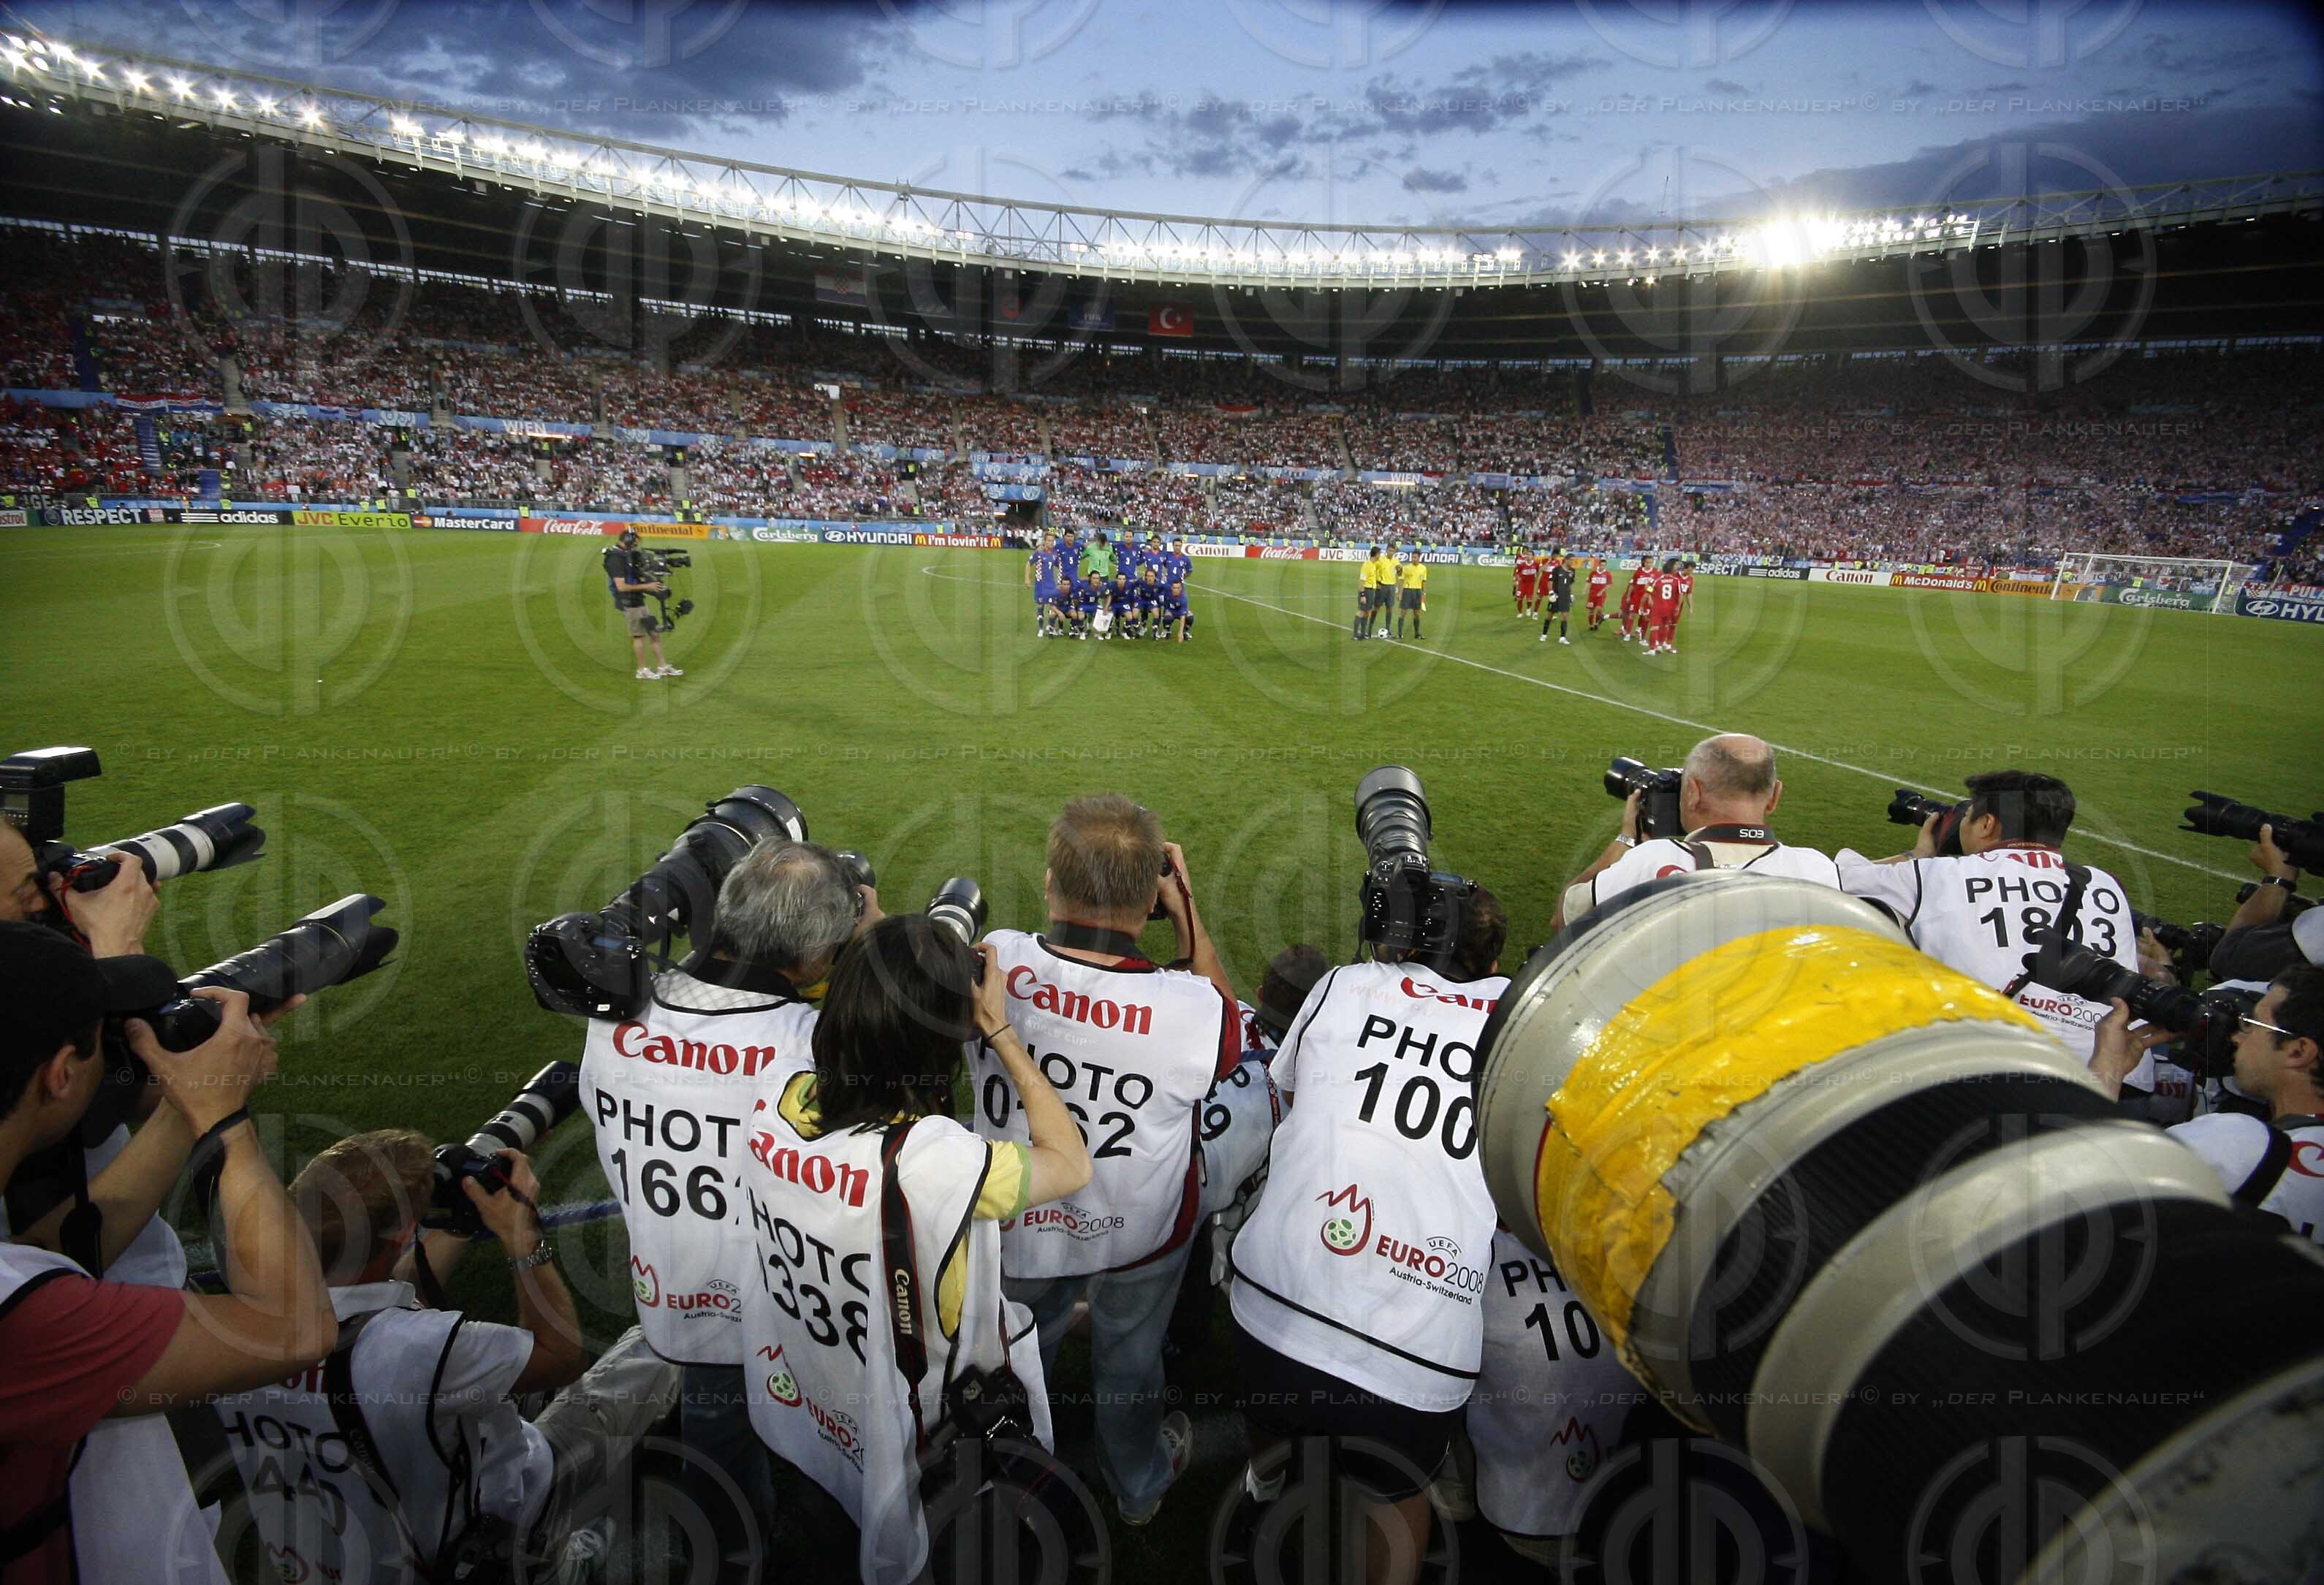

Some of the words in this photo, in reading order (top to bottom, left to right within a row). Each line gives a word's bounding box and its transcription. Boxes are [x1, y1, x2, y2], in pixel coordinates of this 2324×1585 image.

[501, 419, 547, 434] WIEN
[1391, 472, 1420, 483] WIEN
[61, 509, 141, 525] RESPECT
[221, 511, 278, 524] adidas
[297, 512, 334, 525] JVC
[338, 513, 409, 528] Everio
[434, 517, 514, 531] MasterCard
[752, 526, 819, 543] Carlsberg
[846, 531, 912, 544] HYUNDAI
[928, 534, 945, 546] i'm
[1184, 544, 1229, 556] Canon
[1321, 550, 1344, 560] JVC
[1768, 567, 1800, 579] adidas
[1826, 569, 1873, 584] Canon
[1904, 576, 1972, 590] McDonald's
[1661, 584, 1673, 600] 8
[2119, 588, 2191, 608] Carlsberg
[1965, 876, 2119, 915] PHOO
[1006, 965, 1152, 1035] Canon
[612, 1020, 776, 1076] Canon
[1356, 1014, 1476, 1083] PHO
[979, 1040, 1153, 1109] OTO
[1354, 1062, 1478, 1160] 100
[749, 1100, 869, 1208] anon
[611, 1147, 741, 1221] 166
[1429, 1240, 1458, 1258] UEFA
[710, 1281, 737, 1295] UEFA
[1389, 1266, 1473, 1305] Austria-Switzerland
[756, 1240, 869, 1367] 338
[895, 1268, 913, 1335] Canon
